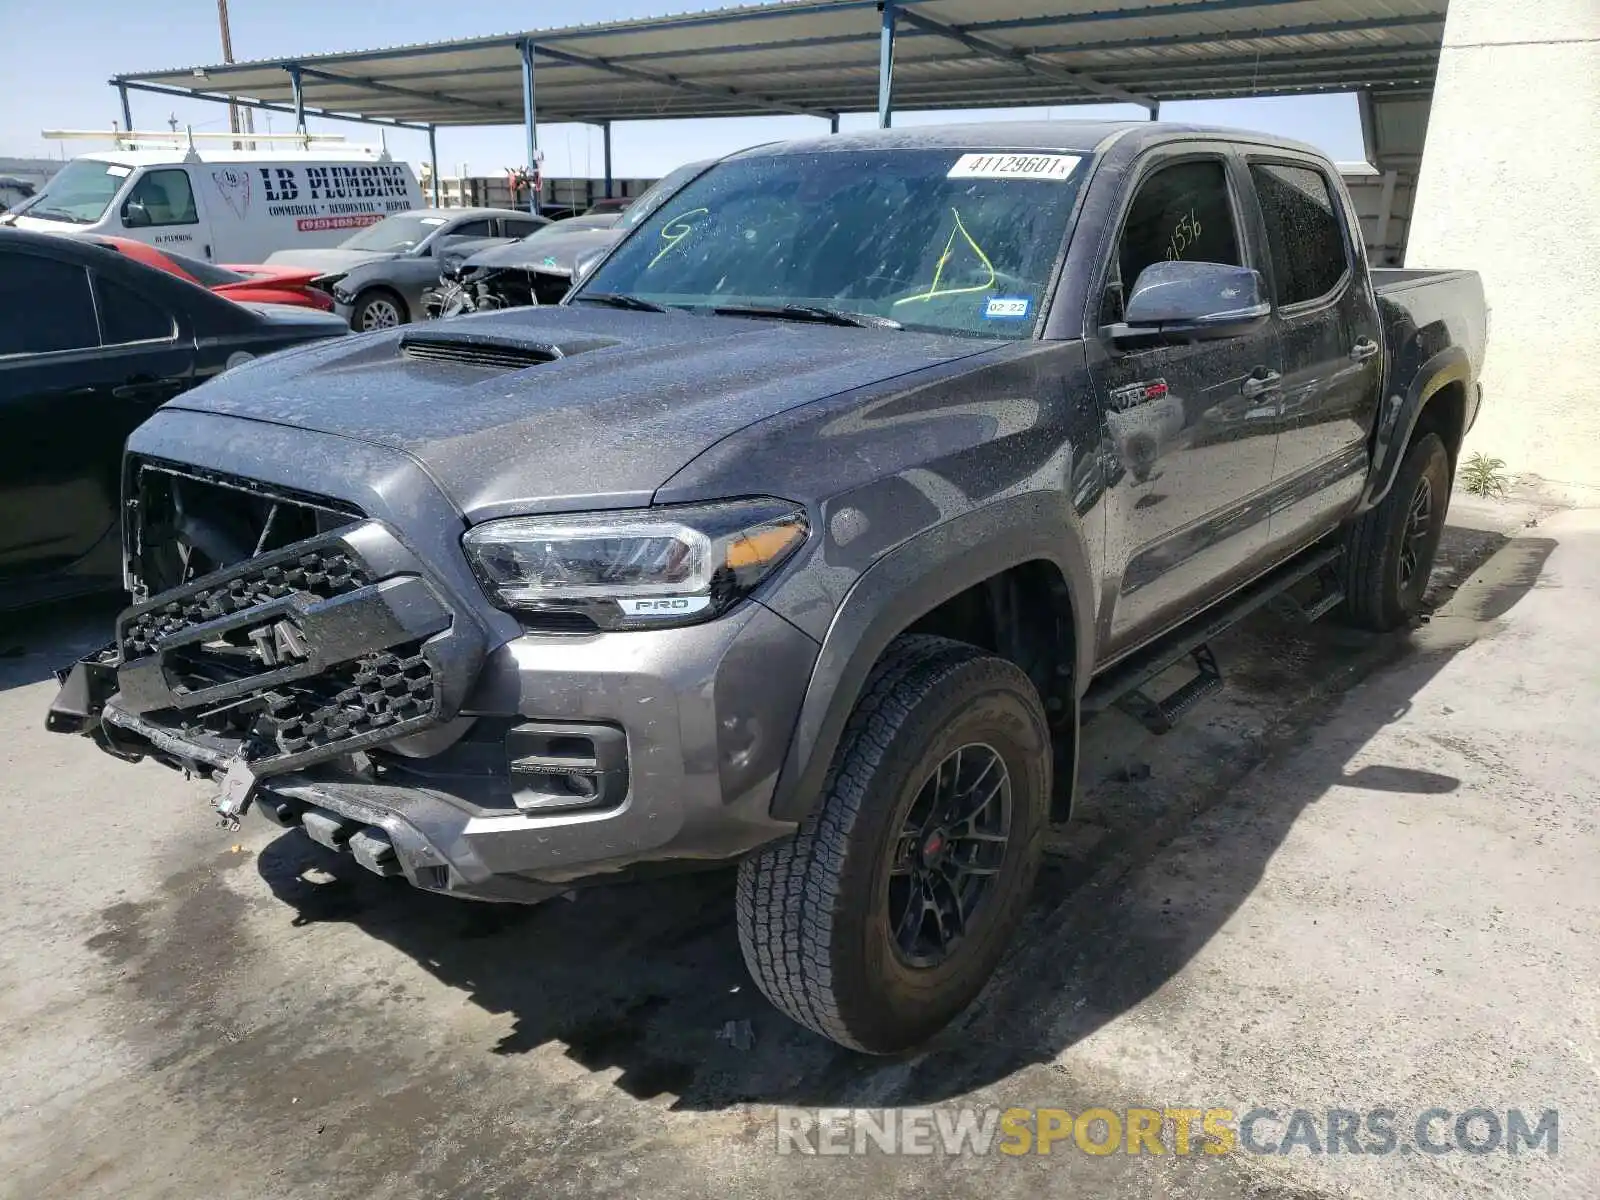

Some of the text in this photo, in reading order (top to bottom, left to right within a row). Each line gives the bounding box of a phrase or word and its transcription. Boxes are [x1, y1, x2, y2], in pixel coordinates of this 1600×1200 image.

[968, 156, 1061, 174] 41129601
[259, 166, 408, 201] LB PLUMBING
[269, 201, 412, 217] COMMERCIAL RESIDENTIAL REPAIR
[990, 303, 1026, 312] 02 22
[635, 599, 689, 610] PRO
